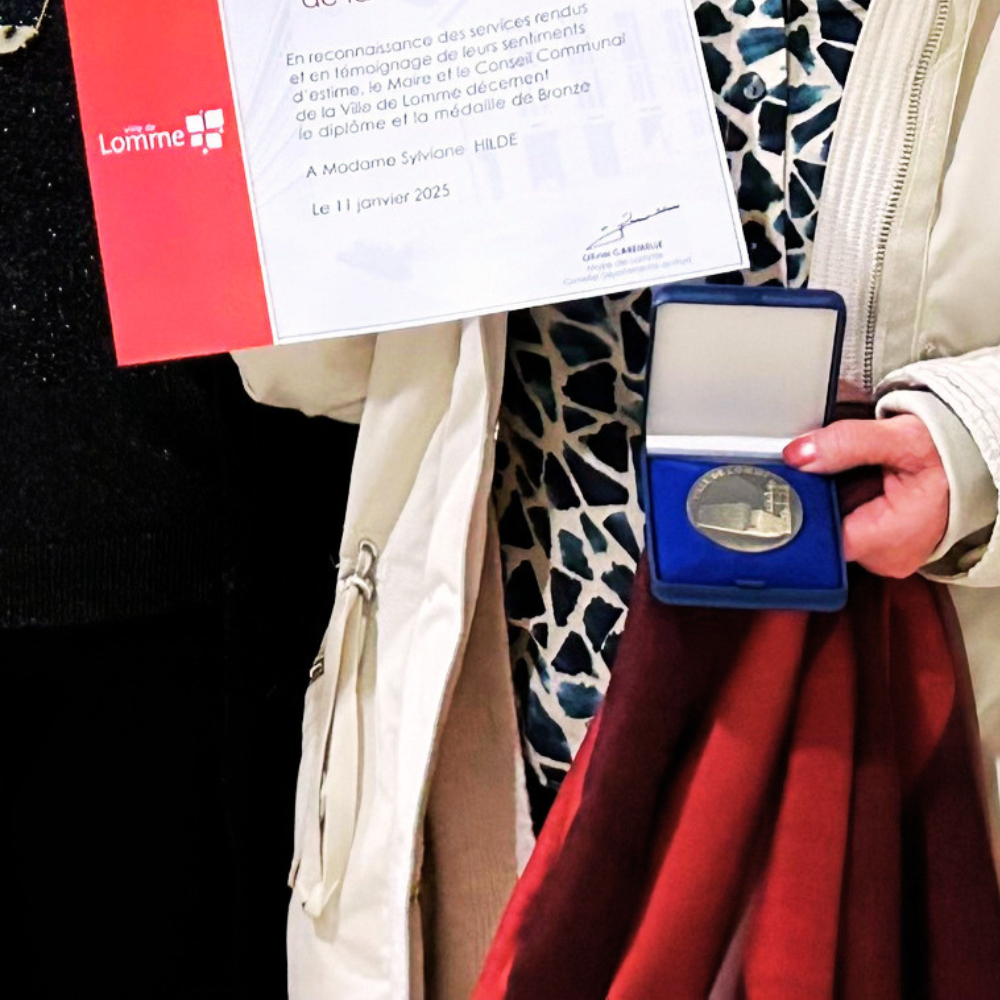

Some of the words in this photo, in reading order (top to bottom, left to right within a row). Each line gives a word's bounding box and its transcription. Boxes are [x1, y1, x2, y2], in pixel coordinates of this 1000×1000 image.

[286, 53, 304, 66] En
[309, 36, 432, 64] reconnaissance
[438, 30, 465, 44] des
[470, 15, 530, 38] services
[535, 3, 588, 25] rendus
[290, 71, 304, 85] et
[310, 70, 329, 82] en
[335, 54, 432, 79] témoignage
[437, 49, 457, 62] de
[463, 42, 498, 58] leurs
[502, 23, 586, 51] sentiments
[368, 80, 382, 93] le
[387, 73, 431, 90] Maire
[437, 67, 452, 82] et
[457, 65, 470, 78] le
[475, 52, 533, 74] Conseil
[536, 32, 626, 62] Communal
[296, 110, 316, 122] de
[321, 106, 336, 119] la
[340, 101, 371, 115] Ville
[377, 97, 397, 110] de
[402, 87, 461, 108] Lomme
[298, 126, 312, 140] le
[319, 118, 386, 138] diplôme
[392, 113, 408, 127] et
[414, 110, 429, 123] la
[434, 98, 506, 120] médaille
[511, 92, 534, 106] de
[538, 80, 591, 102] Bronze
[99, 129, 185, 155] Lomme
[306, 165, 317, 178] A
[323, 154, 396, 176] Madame
[401, 144, 465, 167] Sylviane
[474, 132, 518, 153] HILDE
[312, 203, 329, 216] Le
[356, 191, 409, 213] janvier
[415, 183, 450, 202] 2025
